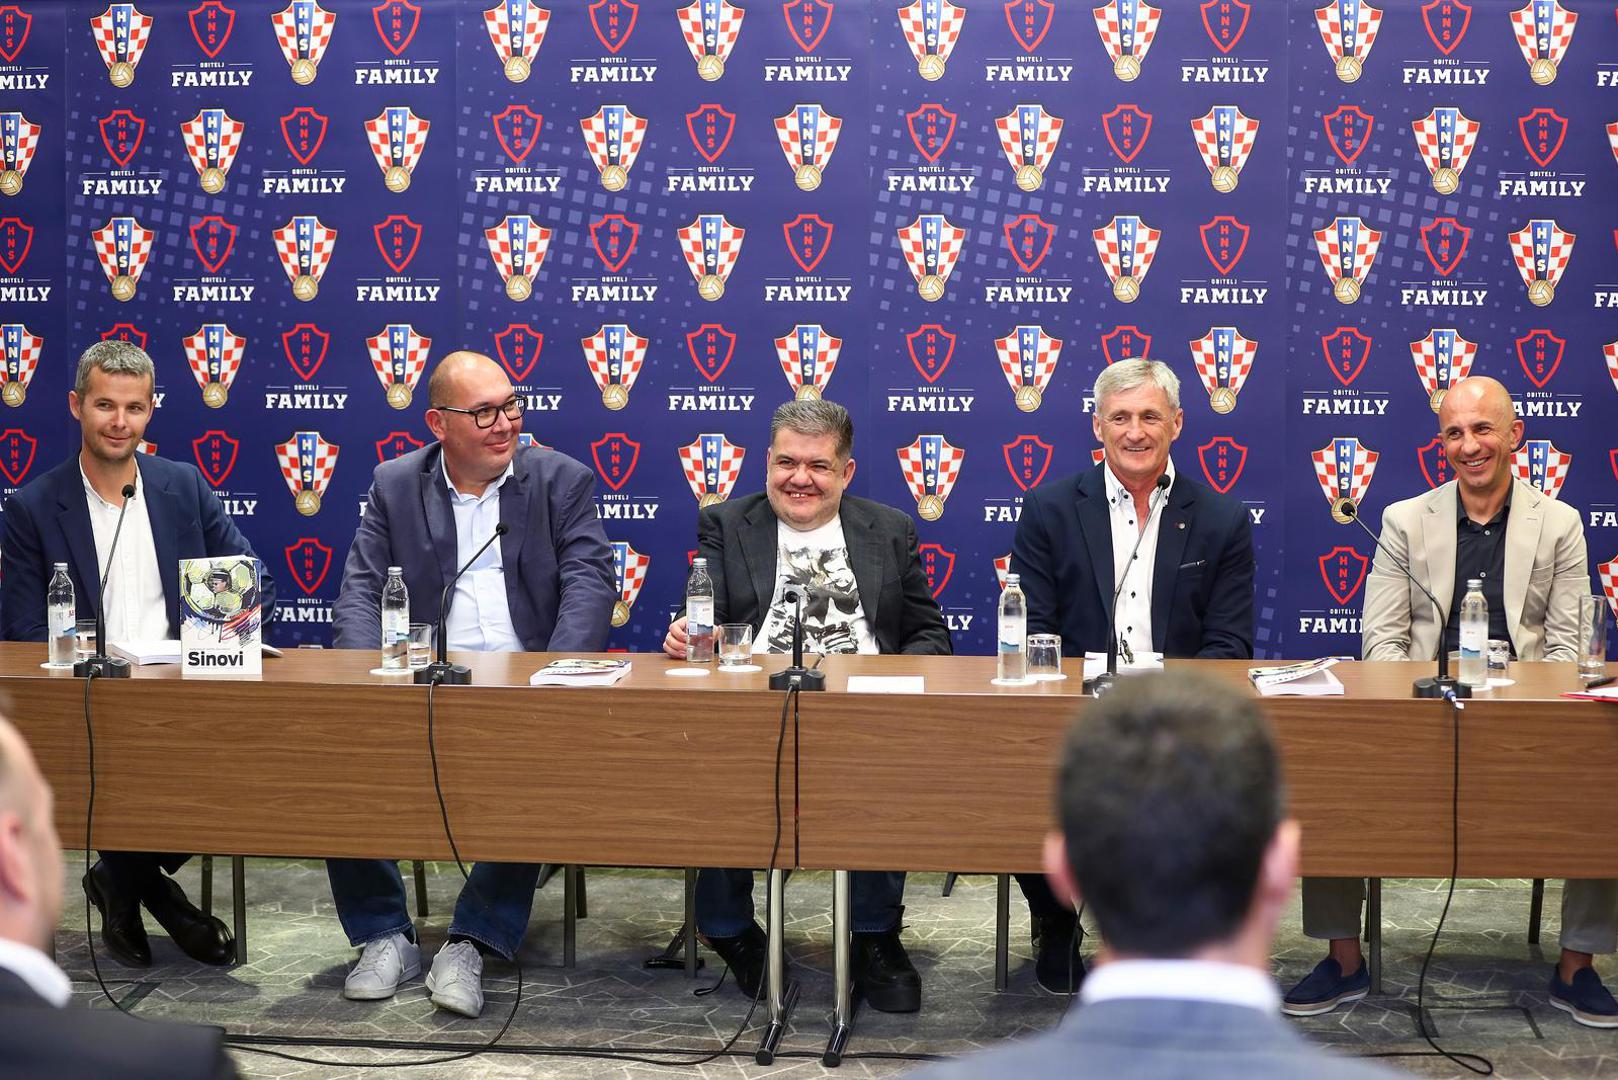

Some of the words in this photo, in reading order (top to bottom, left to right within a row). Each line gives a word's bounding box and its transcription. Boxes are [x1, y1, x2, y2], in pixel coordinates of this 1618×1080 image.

[4, 14, 16, 49] HNS
[116, 10, 128, 54] HNS
[206, 10, 217, 45] HNS
[299, 7, 309, 51] HNS
[392, 6, 402, 42] HNS
[512, 4, 524, 48] HNS
[608, 4, 620, 40] HNS
[706, 2, 716, 46] HNS
[803, 3, 813, 39] HNS
[927, 2, 937, 46] HNS
[1024, 3, 1034, 39] HNS
[1122, 2, 1134, 46] HNS
[1220, 4, 1230, 40] HNS
[1344, 3, 1354, 47] HNS
[1441, 5, 1451, 41] HNS
[1538, 6, 1550, 50] HNS
[0, 74, 48, 90] MILY
[172, 70, 252, 86] FAMILY
[356, 68, 440, 84] FAMILY
[570, 66, 658, 82] FAMILY
[764, 66, 852, 82] FAMILY
[986, 64, 1072, 82] FAMILY
[1182, 66, 1268, 82] FAMILY
[1402, 68, 1490, 84] FAMILY
[5, 119, 17, 163] HNS
[116, 118, 128, 154] HNS
[208, 116, 218, 160] HNS
[298, 116, 310, 152] HNS
[392, 114, 404, 159] HNS
[512, 114, 524, 150] HNS
[609, 113, 619, 157] HNS
[706, 114, 716, 148] HNS
[802, 112, 814, 156] HNS
[926, 112, 938, 148] HNS
[1024, 112, 1036, 156] HNS
[1122, 114, 1132, 150] HNS
[1220, 112, 1230, 157] HNS
[1344, 114, 1354, 150] HNS
[1441, 114, 1451, 159] HNS
[1538, 118, 1548, 154] HNS
[82, 180, 162, 194] FAMILY
[264, 178, 346, 194] FAMILY
[476, 176, 560, 192] FAMILY
[668, 176, 754, 192] FAMILY
[888, 176, 974, 192] FAMILY
[1084, 176, 1170, 192] FAMILY
[1304, 178, 1392, 194] FAMILY
[1500, 180, 1586, 196] FAMILY
[6, 226, 18, 261] HNS
[118, 224, 129, 267] HNS
[208, 224, 218, 260] HNS
[300, 223, 310, 267] HNS
[392, 224, 404, 260] HNS
[512, 222, 524, 266] HNS
[609, 223, 619, 259] HNS
[706, 222, 718, 266] HNS
[802, 224, 814, 260] HNS
[926, 222, 938, 266] HNS
[1023, 224, 1035, 260] HNS
[1122, 222, 1132, 268] HNS
[1220, 224, 1230, 260] HNS
[1342, 224, 1354, 268] HNS
[1440, 226, 1450, 262] HNS
[1536, 226, 1548, 272] HNS
[1, 286, 50, 302] MILY
[174, 286, 254, 302] FAMILY
[356, 286, 440, 302] FAMILY
[572, 286, 658, 302] FAMILY
[764, 286, 852, 302] FAMILY
[986, 286, 1072, 302] FAMILY
[1180, 288, 1268, 304] FAMILY
[1402, 290, 1488, 306] FAMILY
[8, 330, 18, 374] HNS
[210, 330, 220, 374] HNS
[300, 332, 312, 368] HNS
[393, 331, 406, 376] HNS
[513, 333, 525, 369] HNS
[610, 332, 620, 376] HNS
[706, 332, 718, 368] HNS
[802, 332, 814, 376] HNS
[926, 334, 936, 370] HNS
[1024, 332, 1034, 378] HNS
[1121, 335, 1131, 357] HN
[1218, 334, 1230, 378] HNS
[1342, 336, 1352, 372] HNS
[1438, 336, 1450, 380] HNS
[1534, 338, 1546, 374] HNS
[266, 394, 348, 410] FAMILY
[524, 395, 562, 410] ILY
[668, 396, 754, 410] FAMILY
[888, 396, 974, 412] FAMILY
[1302, 398, 1388, 414] FAMILY
[1512, 401, 1582, 416] AMILY
[9, 437, 21, 472] HNS
[210, 439, 222, 474] HNS
[302, 438, 314, 482] HNS
[610, 442, 622, 477] HNS
[707, 441, 717, 485] HNS
[926, 442, 936, 486] HNS
[1022, 444, 1034, 480] HNS
[1218, 446, 1228, 482] HNS
[1340, 445, 1350, 489] HNS
[1436, 447, 1446, 482] HNS
[1533, 447, 1543, 490] HNS
[223, 500, 257, 515] ILY
[595, 503, 659, 519] MILY
[304, 546, 314, 582] HNS
[925, 553, 937, 588] HNS
[1338, 555, 1350, 591] HNS
[1299, 618, 1363, 633] FAMI
[188, 651, 243, 666] Sinovi
